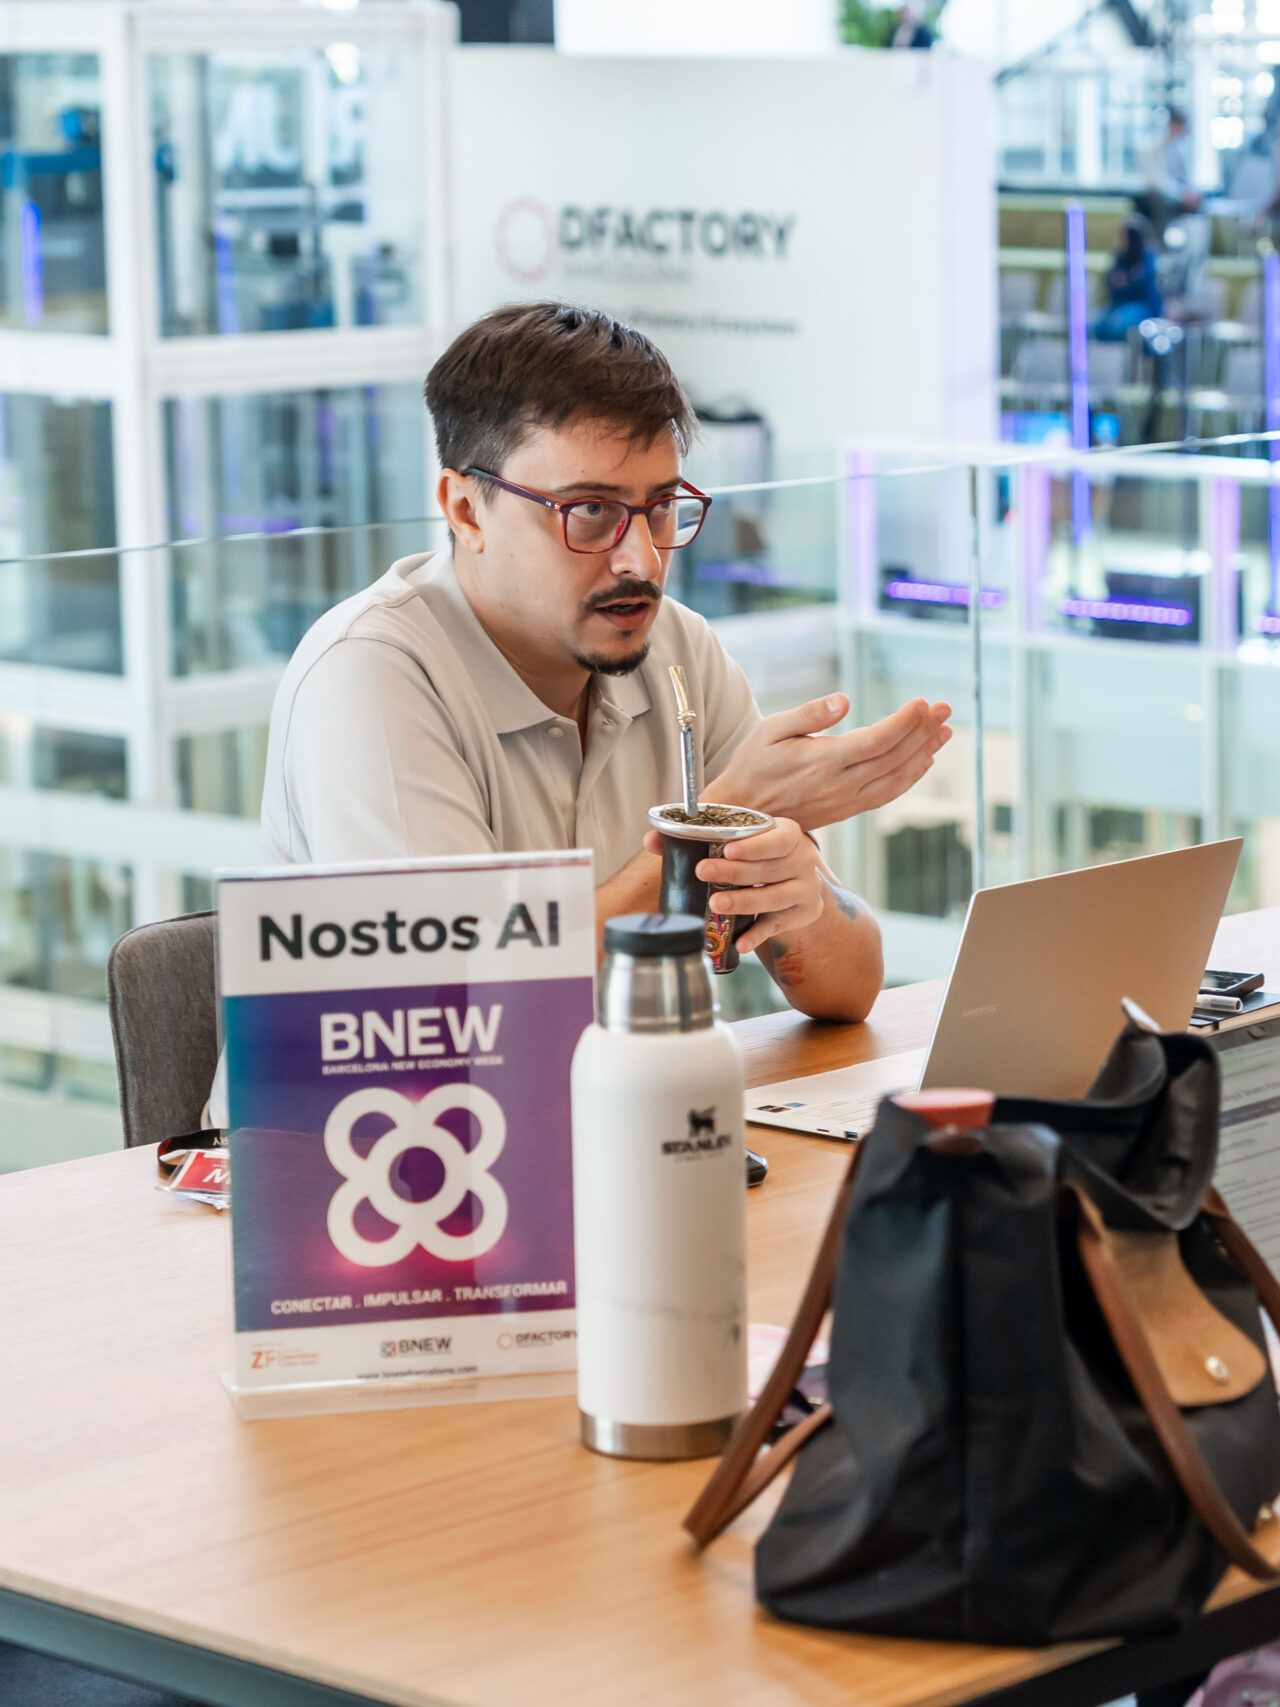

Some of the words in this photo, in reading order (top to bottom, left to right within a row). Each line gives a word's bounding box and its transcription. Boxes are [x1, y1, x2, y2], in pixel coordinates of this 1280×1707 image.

[559, 204, 796, 258] DFACTORY
[258, 911, 480, 961] Nostos
[495, 901, 561, 951] AI
[320, 1004, 503, 1061] BNEW
[321, 1061, 389, 1076] BARCELONA
[391, 1059, 416, 1071] NEW
[418, 1056, 468, 1070] ECONOMY
[270, 1295, 352, 1316] CONECTAR
[364, 1288, 443, 1308] IMPULSAR
[455, 1280, 568, 1301] TRANSFORMAR
[398, 1336, 452, 1353] BNEW
